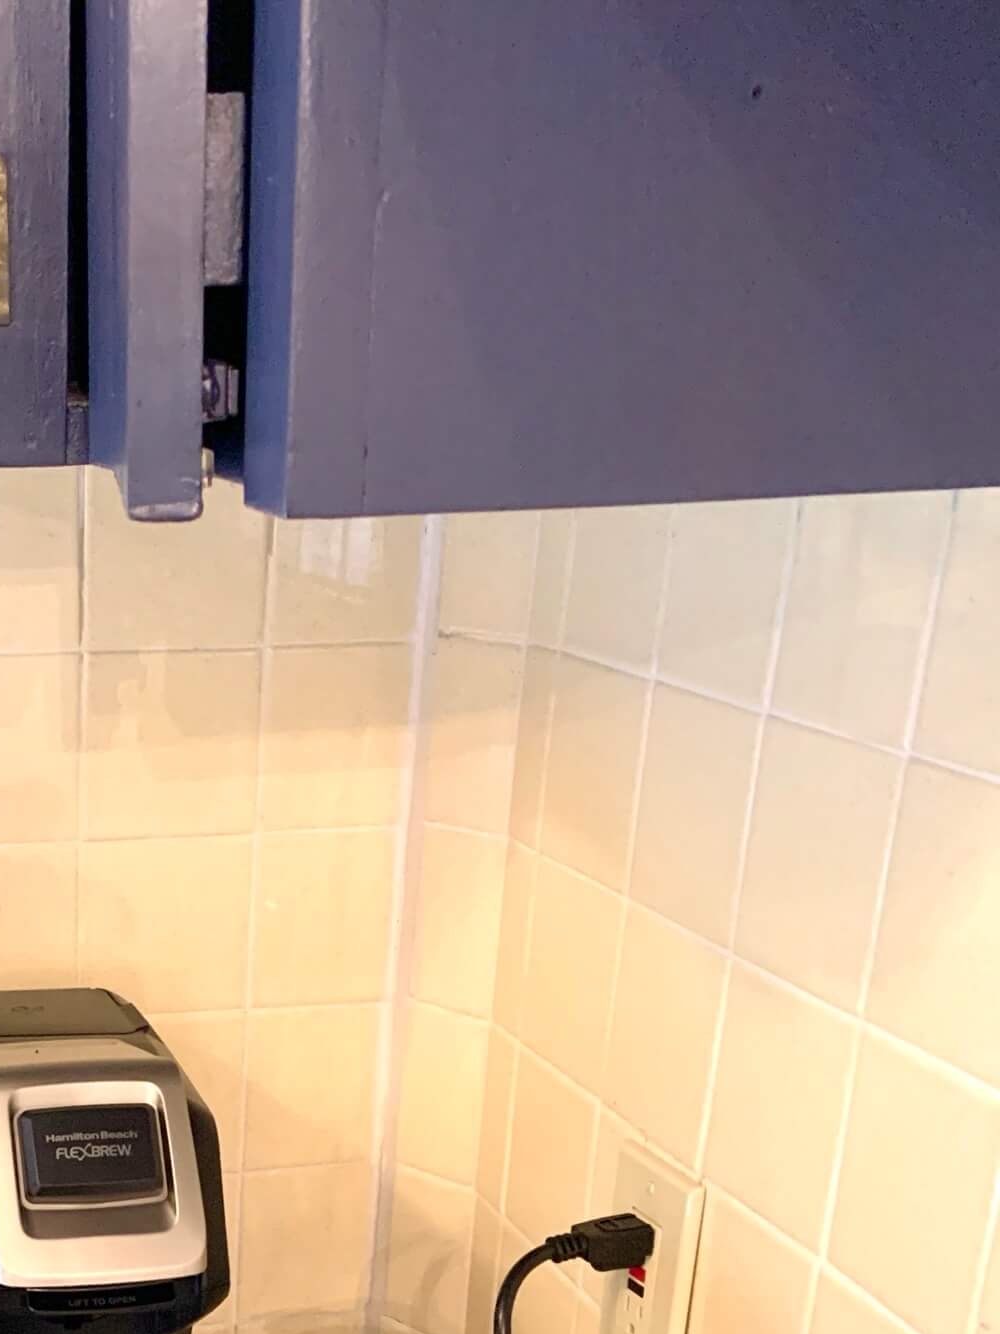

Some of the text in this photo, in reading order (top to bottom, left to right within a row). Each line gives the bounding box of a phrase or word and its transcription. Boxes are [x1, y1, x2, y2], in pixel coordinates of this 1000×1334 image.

[45, 1130, 138, 1142] Hamilton Beach
[56, 1143, 132, 1161] FLEXBREW
[92, 1297, 106, 1305] TO
[108, 1296, 136, 1304] OPEN
